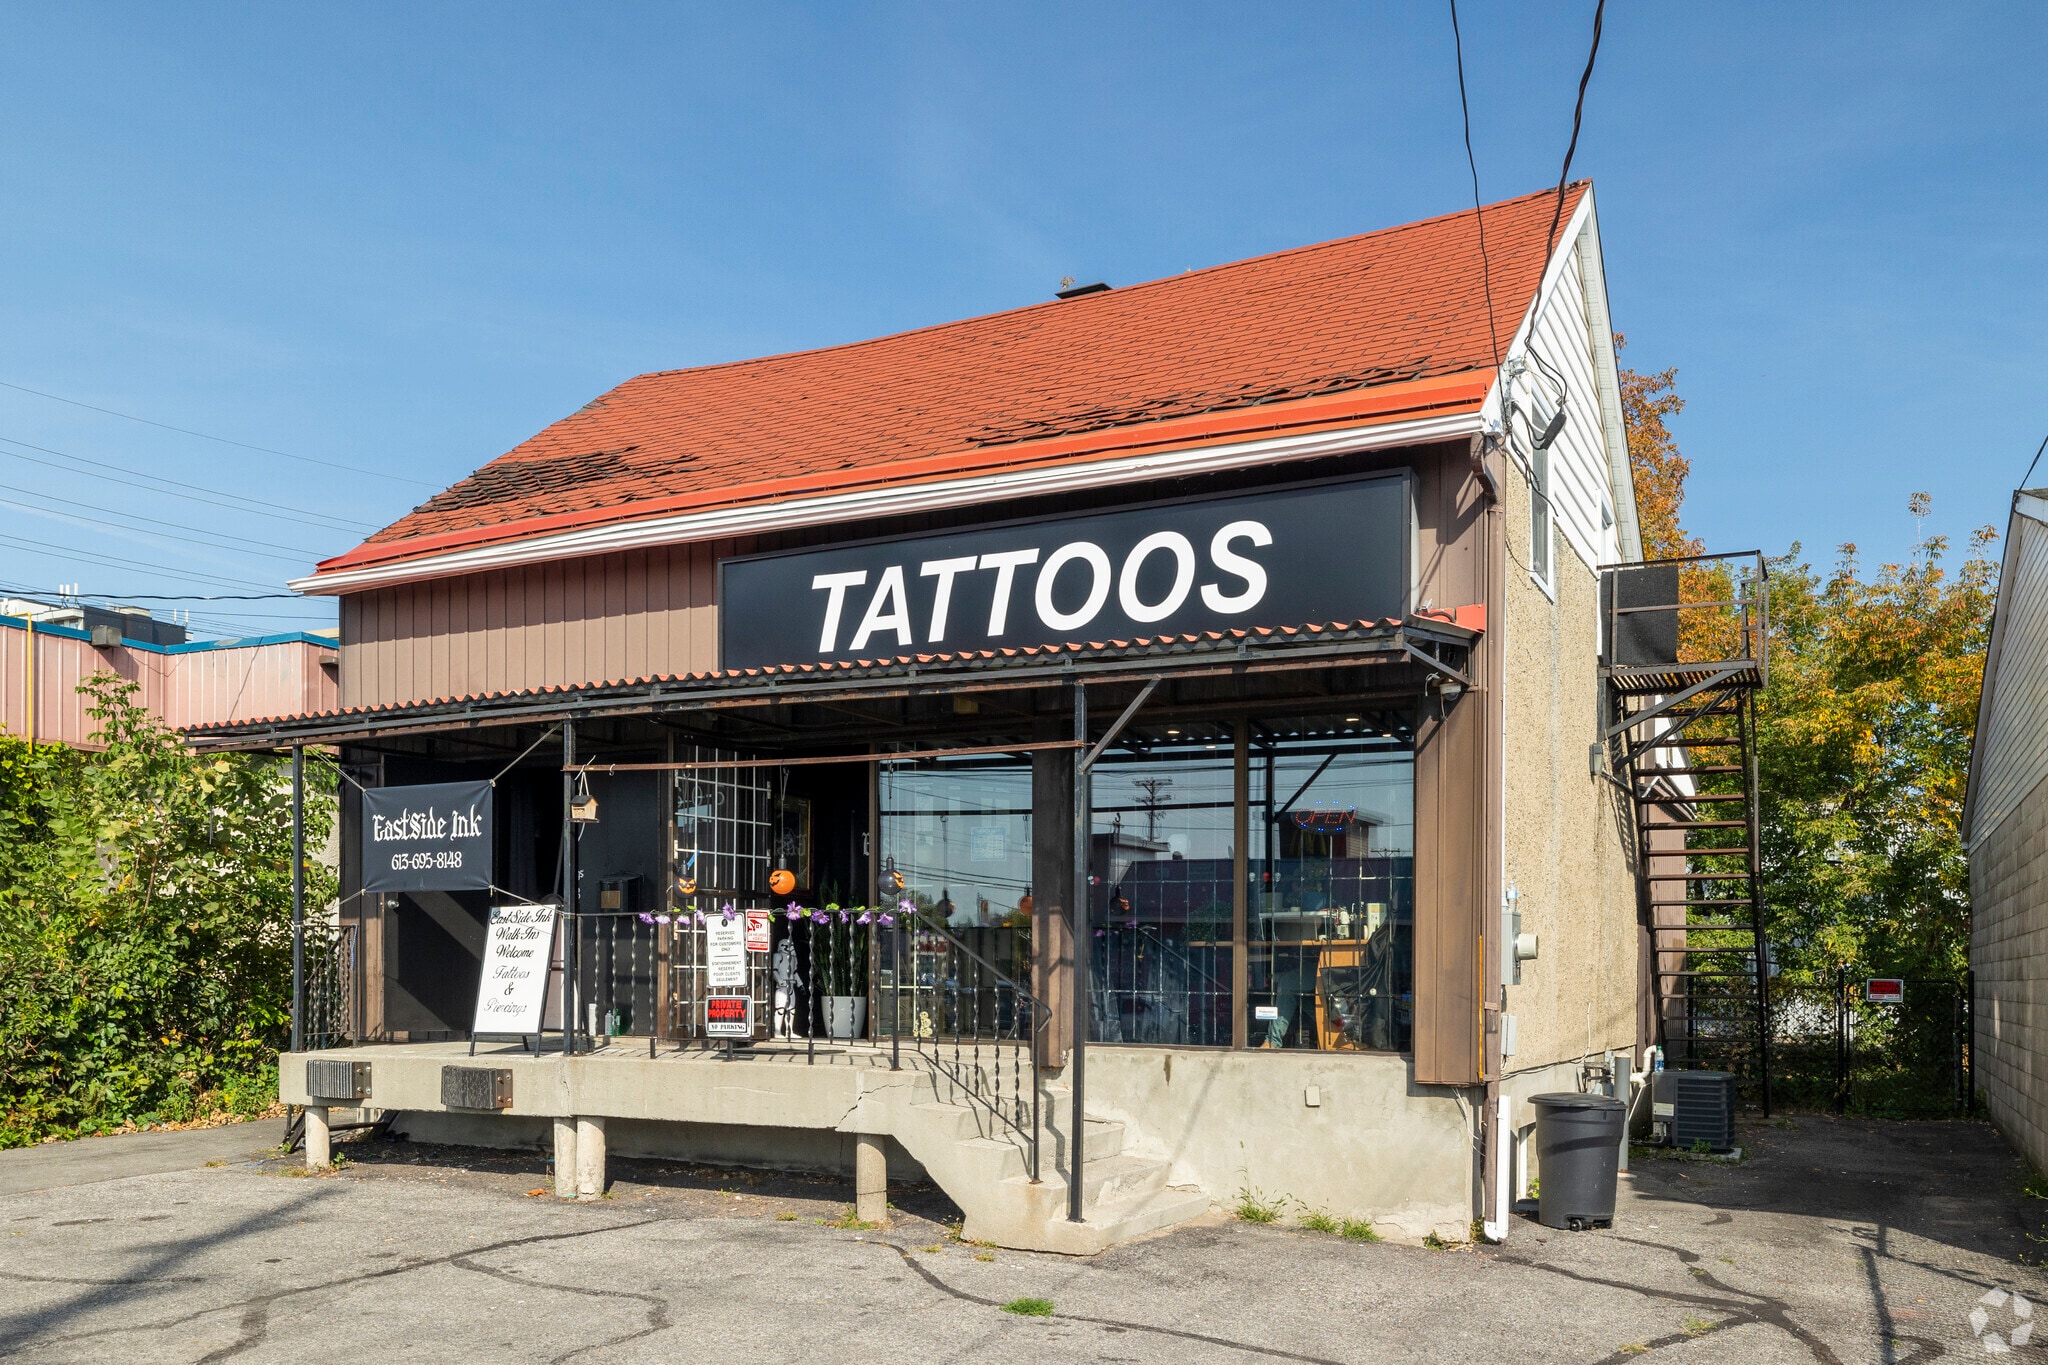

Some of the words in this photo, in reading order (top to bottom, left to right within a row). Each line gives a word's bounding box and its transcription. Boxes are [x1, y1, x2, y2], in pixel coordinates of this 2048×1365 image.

[811, 520, 1273, 653] TATTOOS
[450, 804, 482, 841] Ink
[1295, 808, 1357, 824] OPEN
[391, 851, 462, 870] 613-695-8148
[531, 908, 553, 923] Ink
[495, 926, 540, 941] Walk-Ins
[496, 944, 534, 958] Welcome
[492, 964, 530, 979] Tattoos
[504, 982, 514, 996] &
[484, 998, 527, 1017] Piercings
[711, 1000, 742, 1009] PRIVATE
[708, 1009, 746, 1018] PROPERTY
